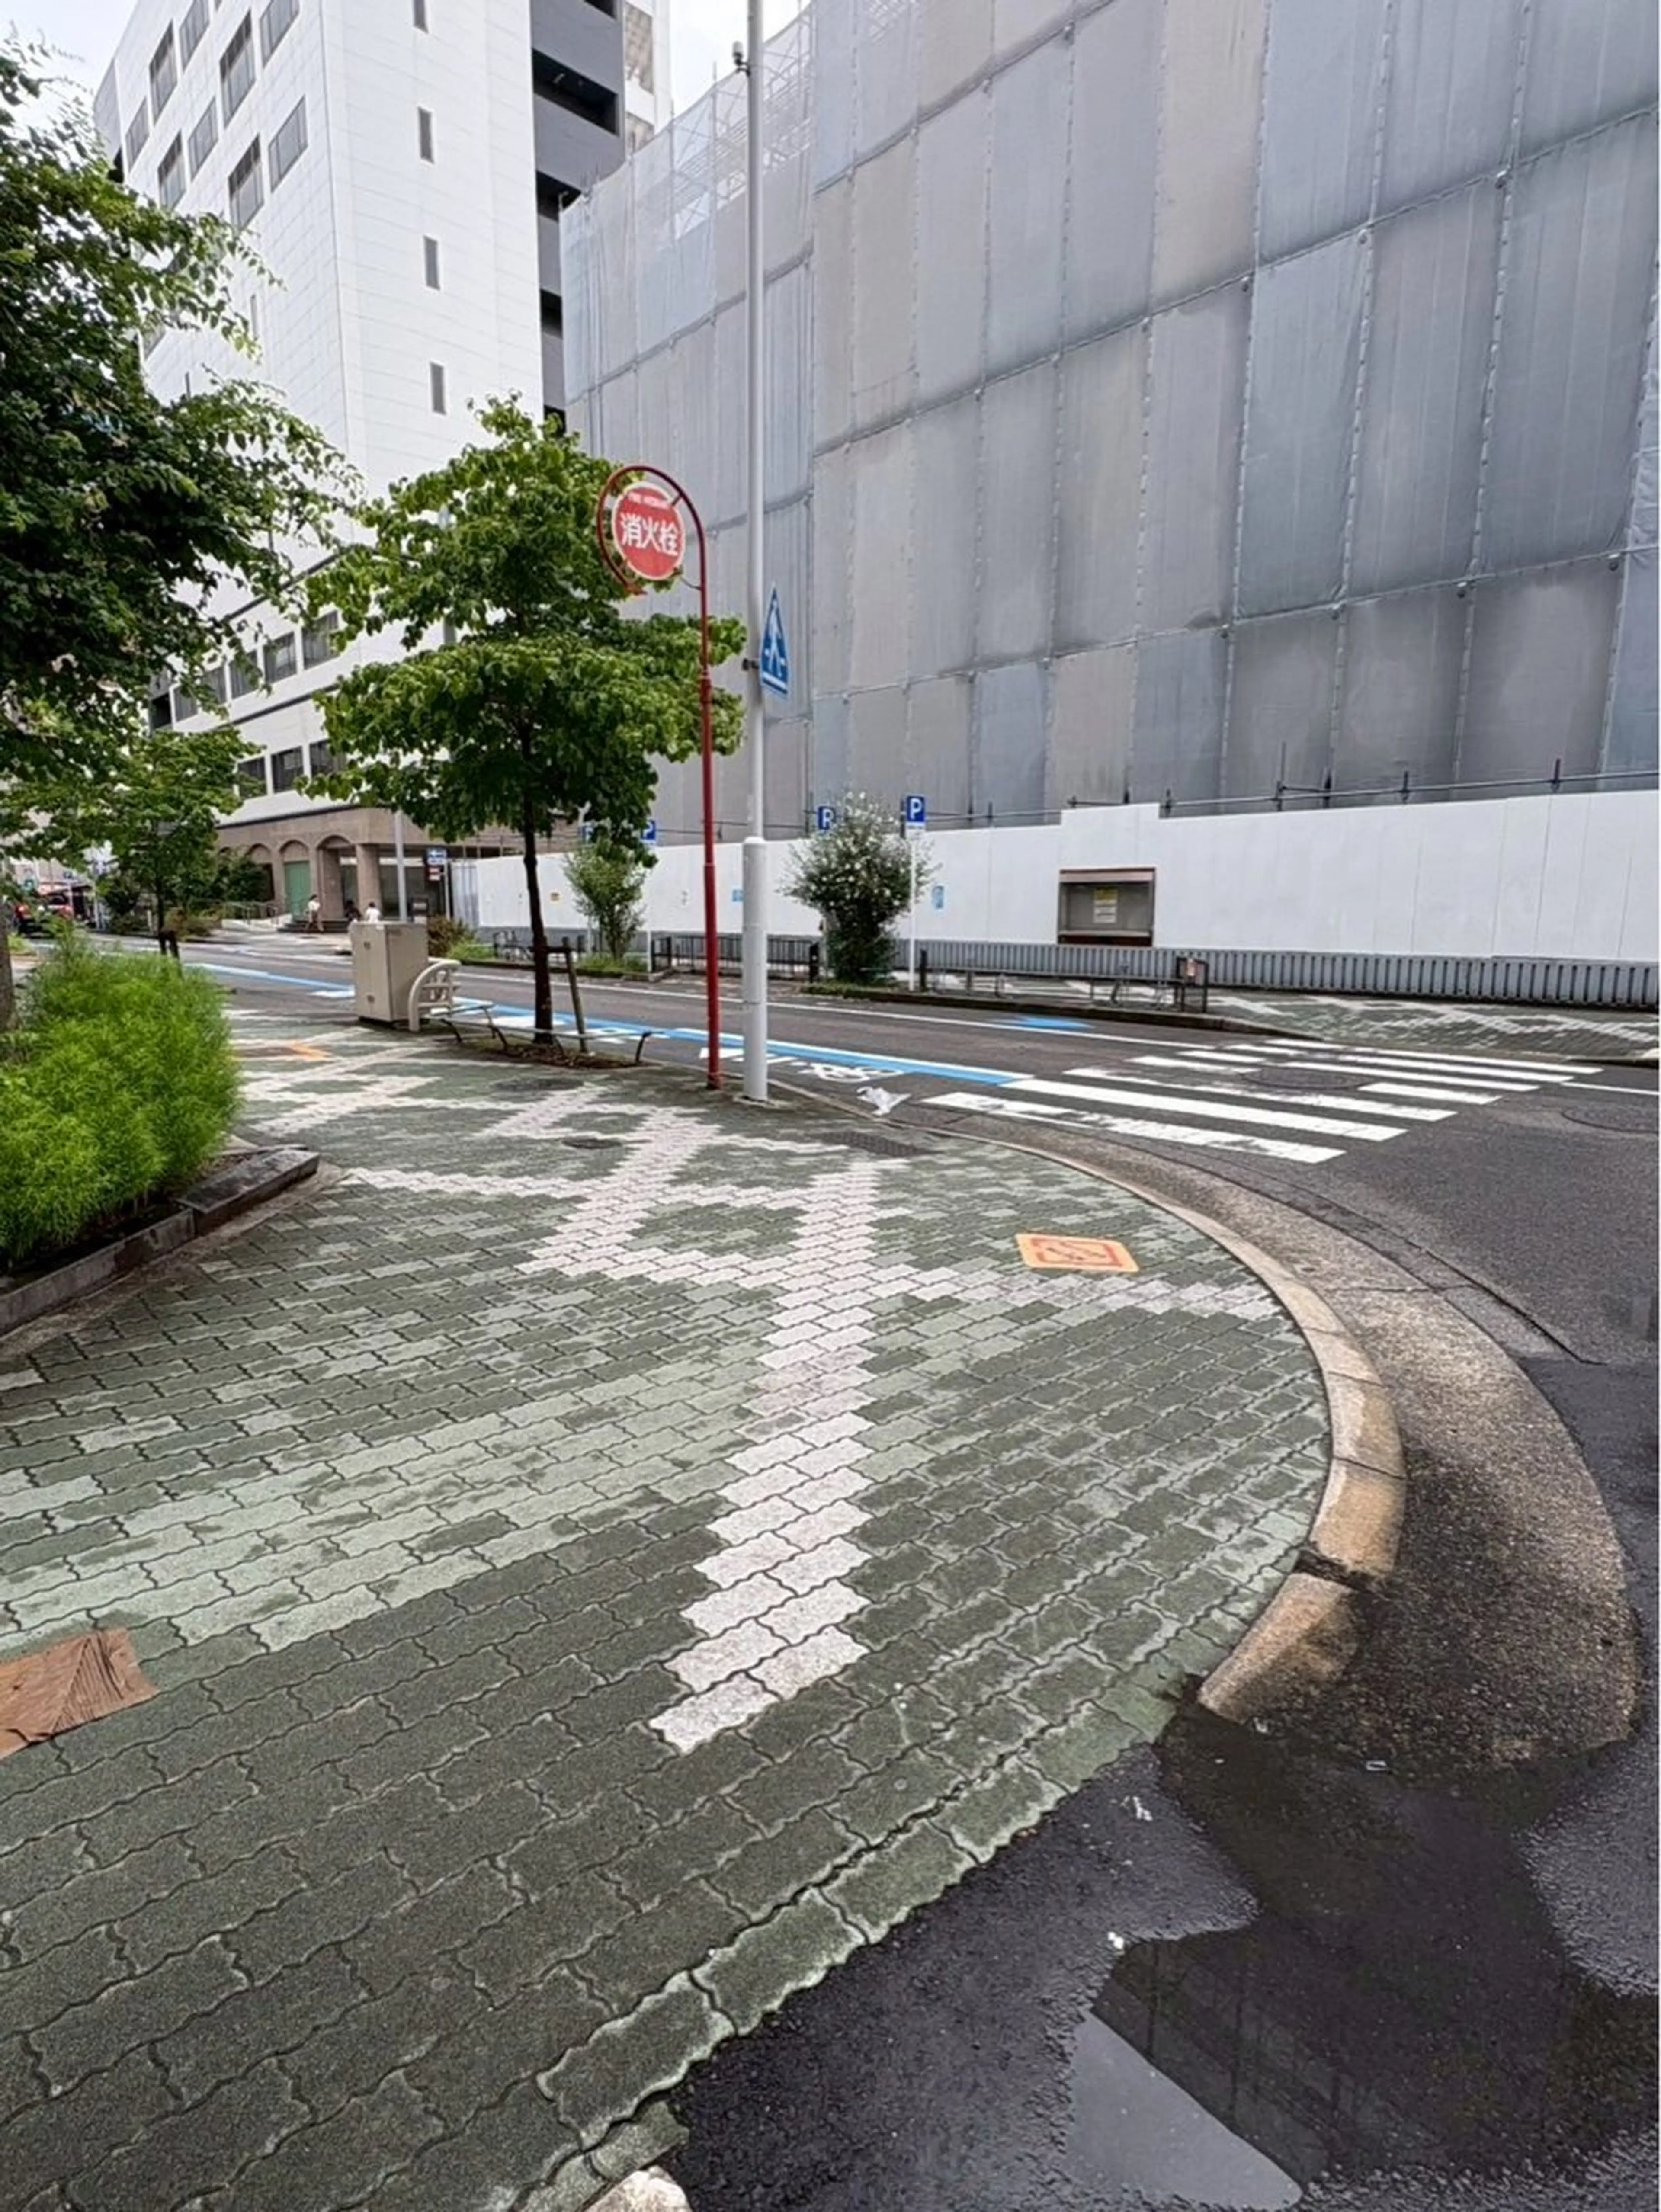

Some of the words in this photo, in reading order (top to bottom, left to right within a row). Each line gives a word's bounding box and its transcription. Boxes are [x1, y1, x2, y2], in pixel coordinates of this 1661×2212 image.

[620, 512, 678, 556] 消火栓
[910, 798, 922, 820] P
